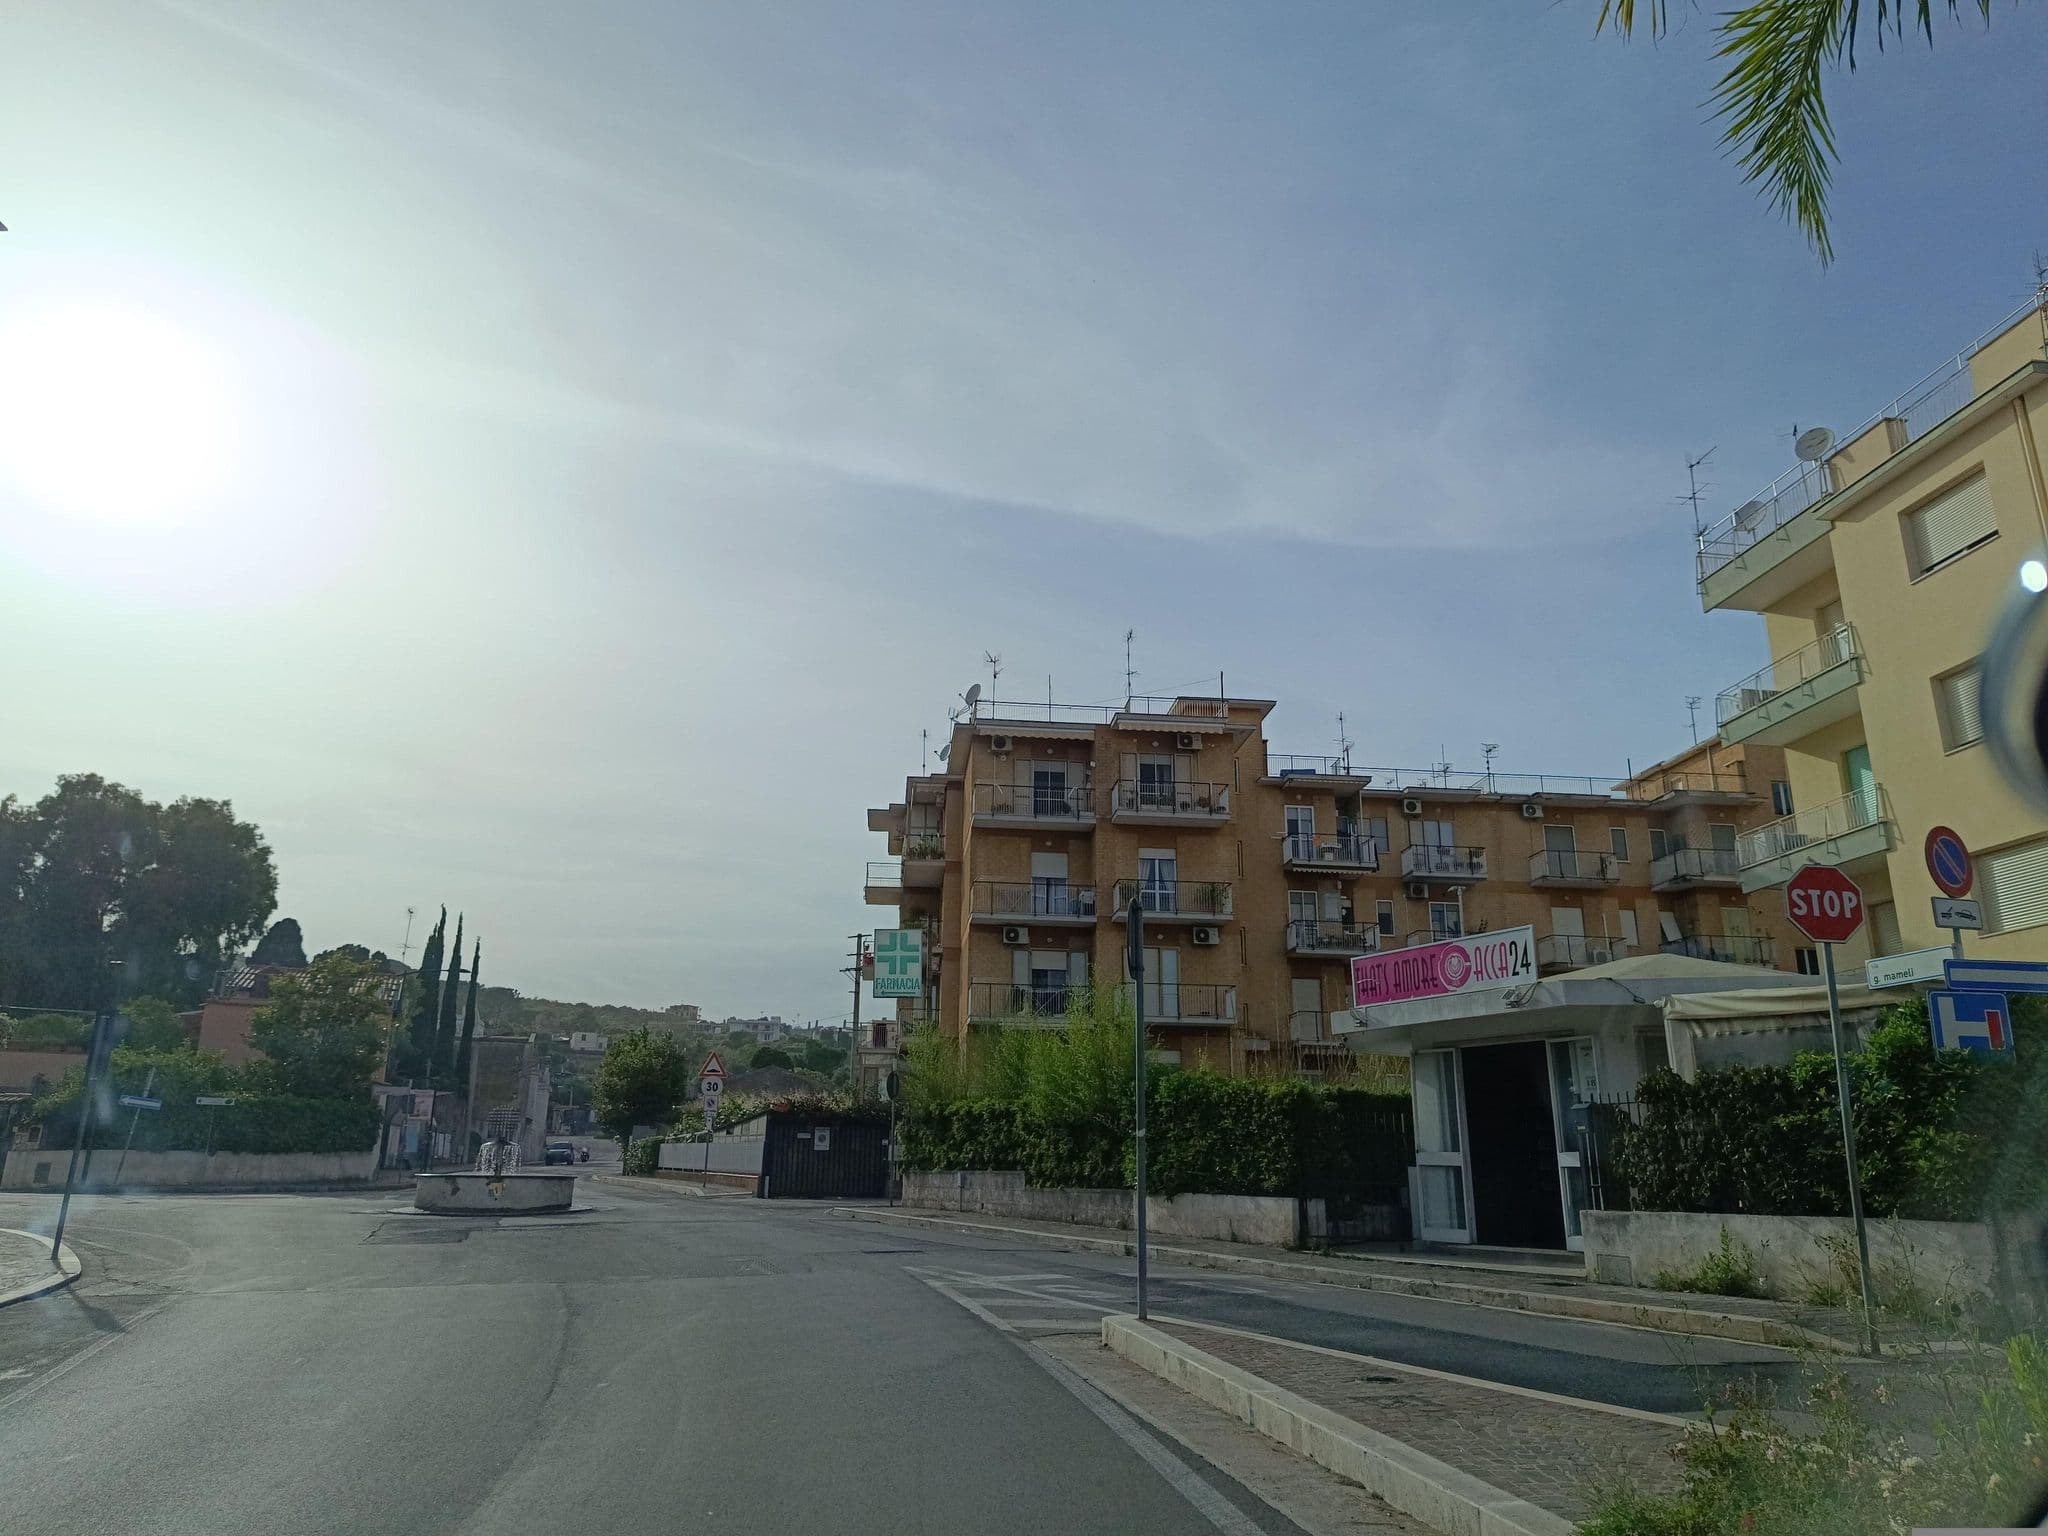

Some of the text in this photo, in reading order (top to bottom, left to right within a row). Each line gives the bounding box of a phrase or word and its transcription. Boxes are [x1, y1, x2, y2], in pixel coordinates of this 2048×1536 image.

[1791, 888, 1858, 918] STOP
[1393, 954, 1439, 993] AMORE
[1884, 968, 1914, 981] mameli
[875, 977, 920, 990] FARMACIA
[706, 1081, 719, 1092] 30
